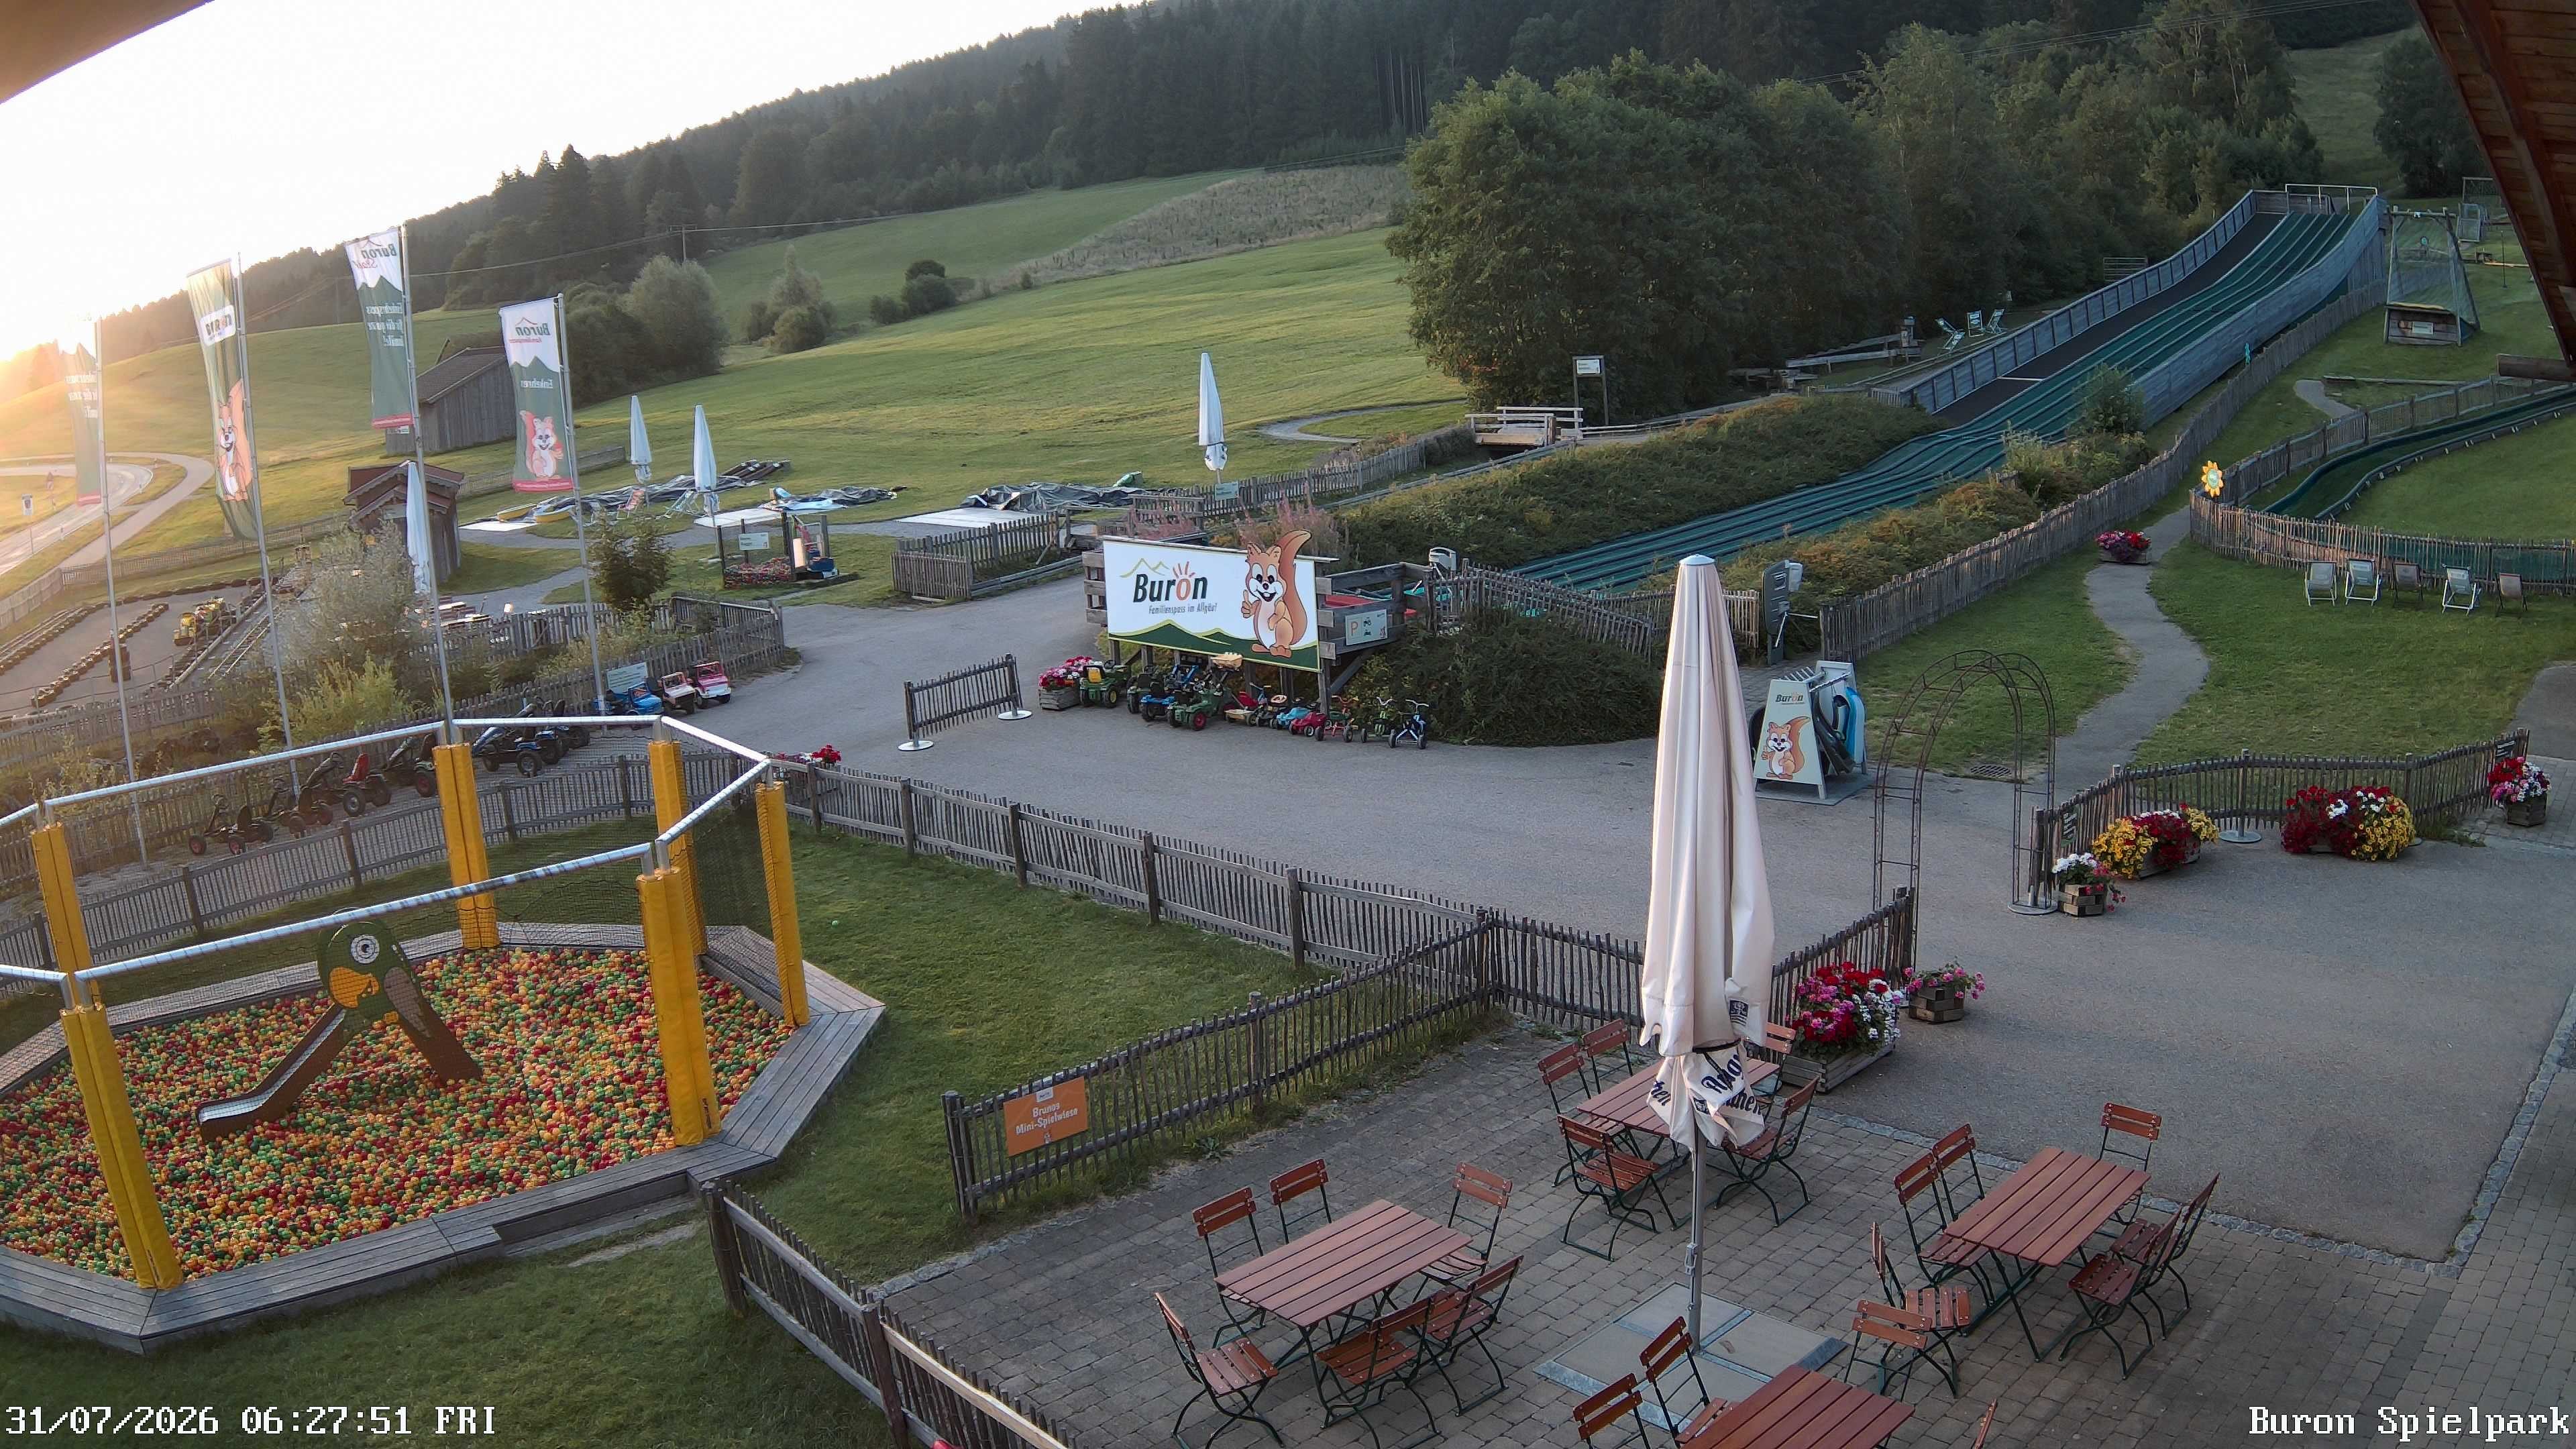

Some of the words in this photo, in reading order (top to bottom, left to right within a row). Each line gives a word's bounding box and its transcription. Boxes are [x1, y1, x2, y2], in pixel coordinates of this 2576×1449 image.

[1133, 574, 1208, 602] Buron
[1775, 694, 1804, 702] Buron
[1032, 1102, 1061, 1118] Brunos
[1015, 1108, 1079, 1135] Mini-Spielwiese
